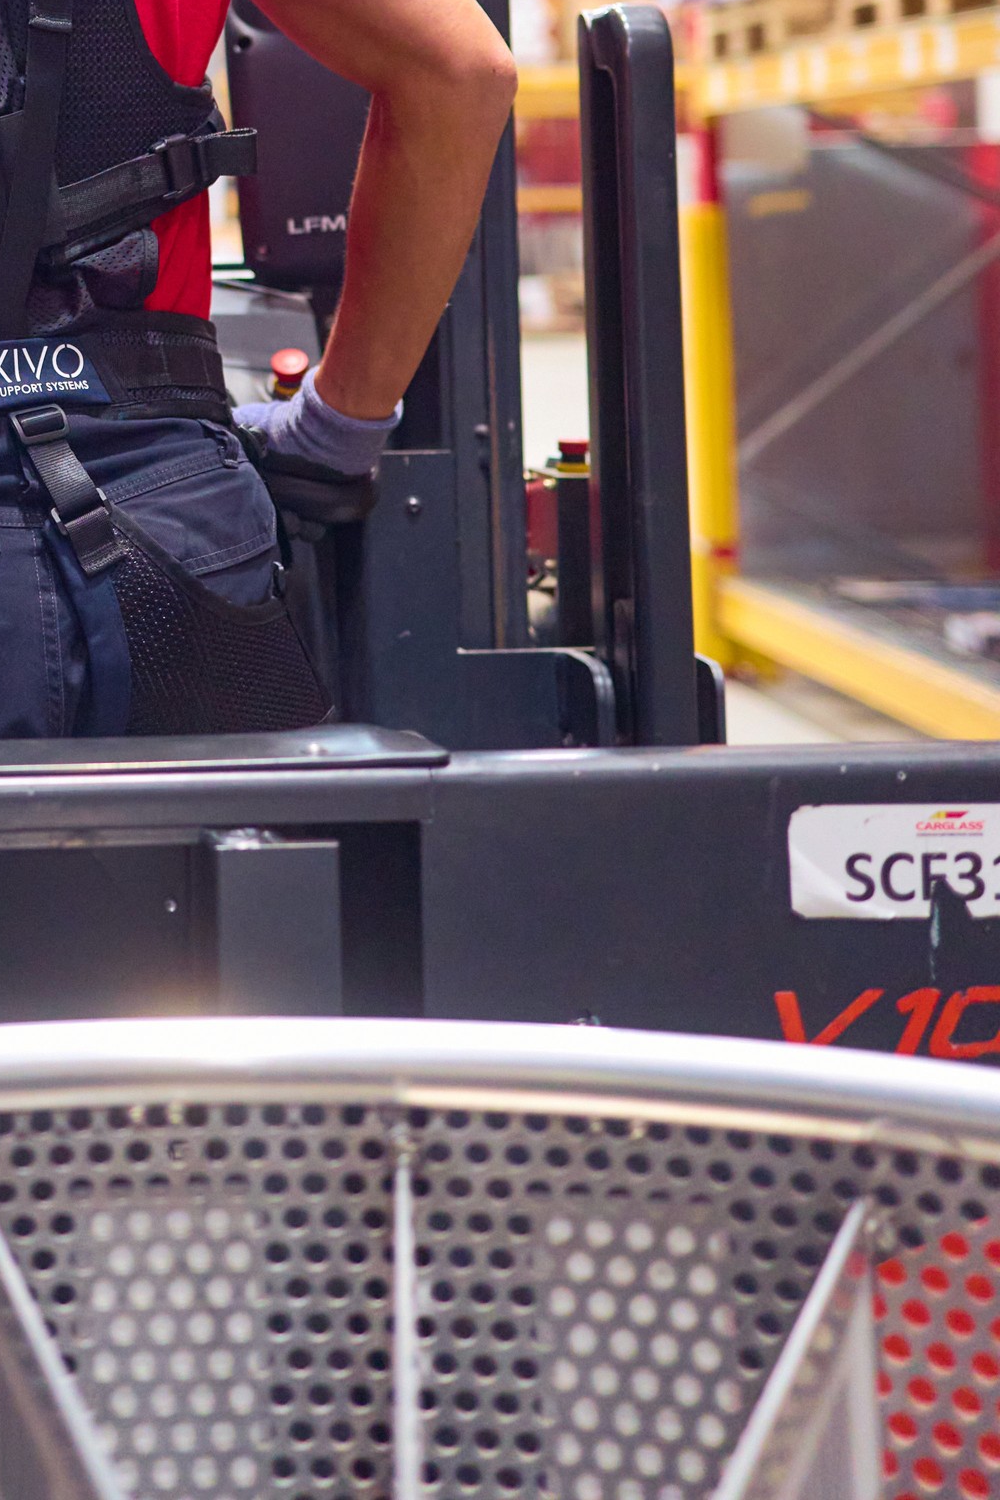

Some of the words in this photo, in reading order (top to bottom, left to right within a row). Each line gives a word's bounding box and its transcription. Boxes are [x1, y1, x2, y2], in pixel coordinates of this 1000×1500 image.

[46, 379, 90, 392] SYSTEMS
[915, 820, 984, 831] CARGLASS
[845, 851, 1000, 903] SCF3
